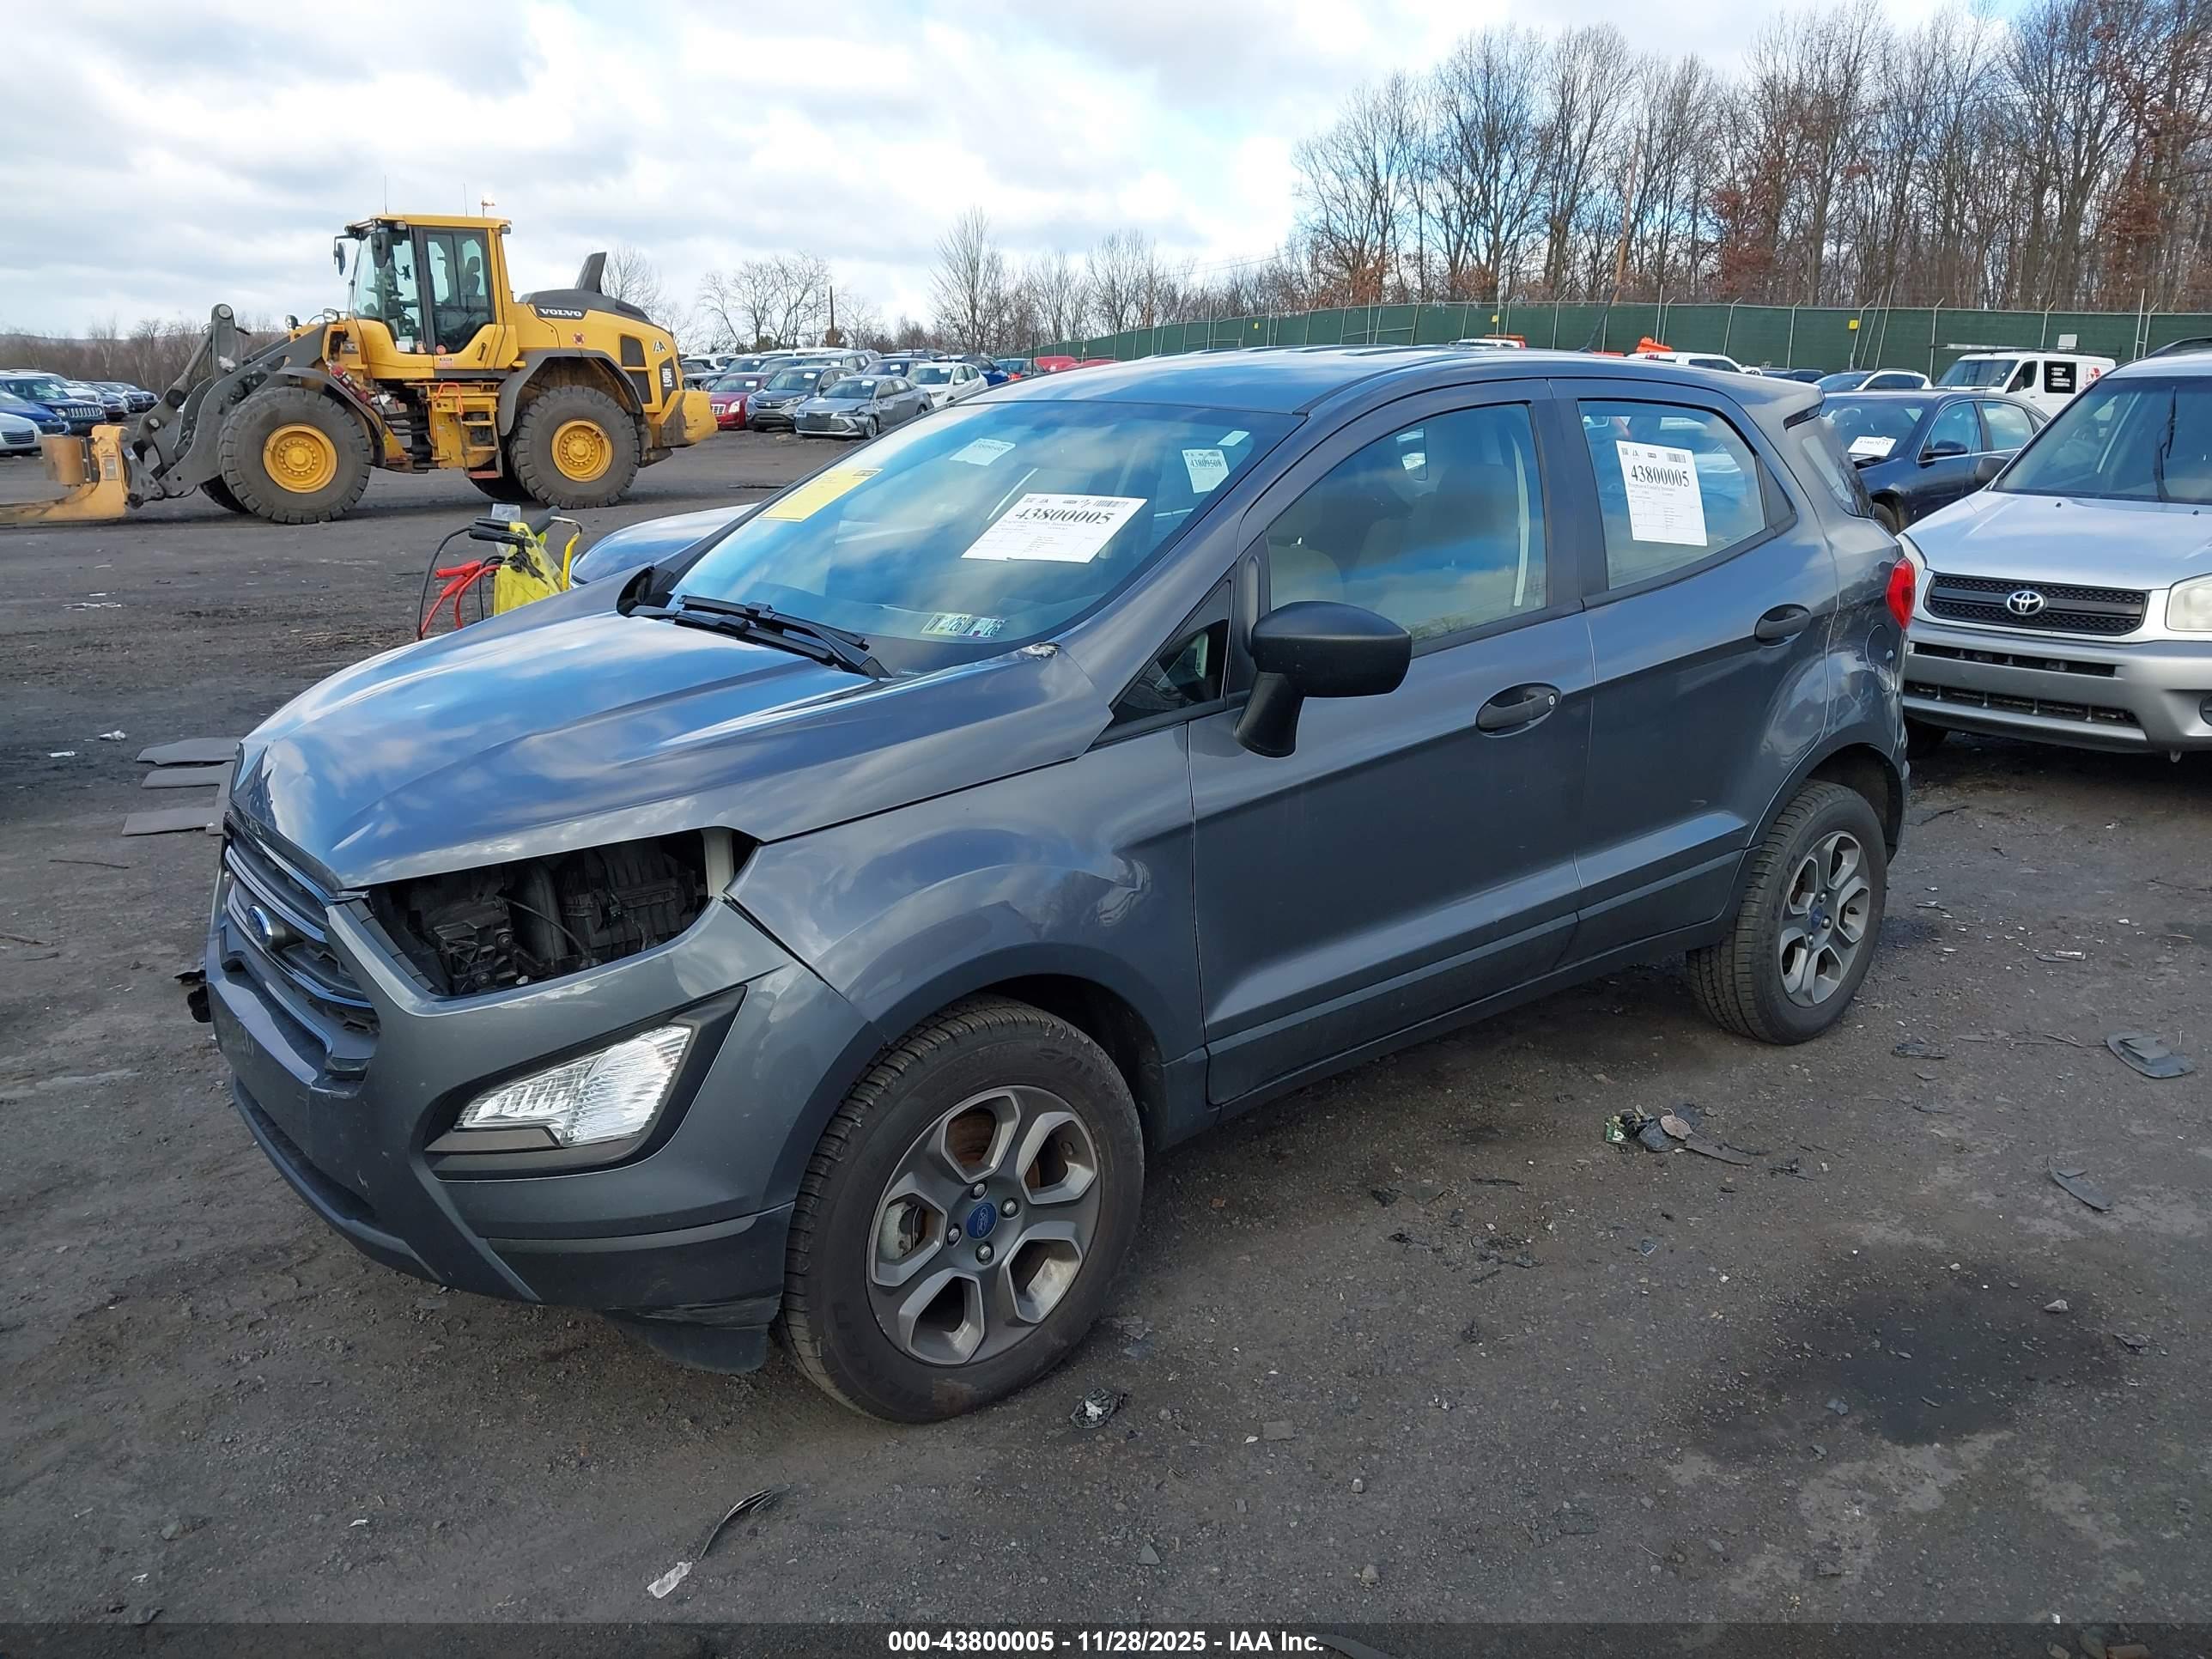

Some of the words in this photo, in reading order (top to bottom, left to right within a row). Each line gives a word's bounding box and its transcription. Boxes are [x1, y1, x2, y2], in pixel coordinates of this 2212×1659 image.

[538, 307, 583, 318] VOLVO
[661, 368, 673, 387] L90H
[1631, 465, 1690, 487] 43800005
[1014, 507, 1115, 525] 43800005
